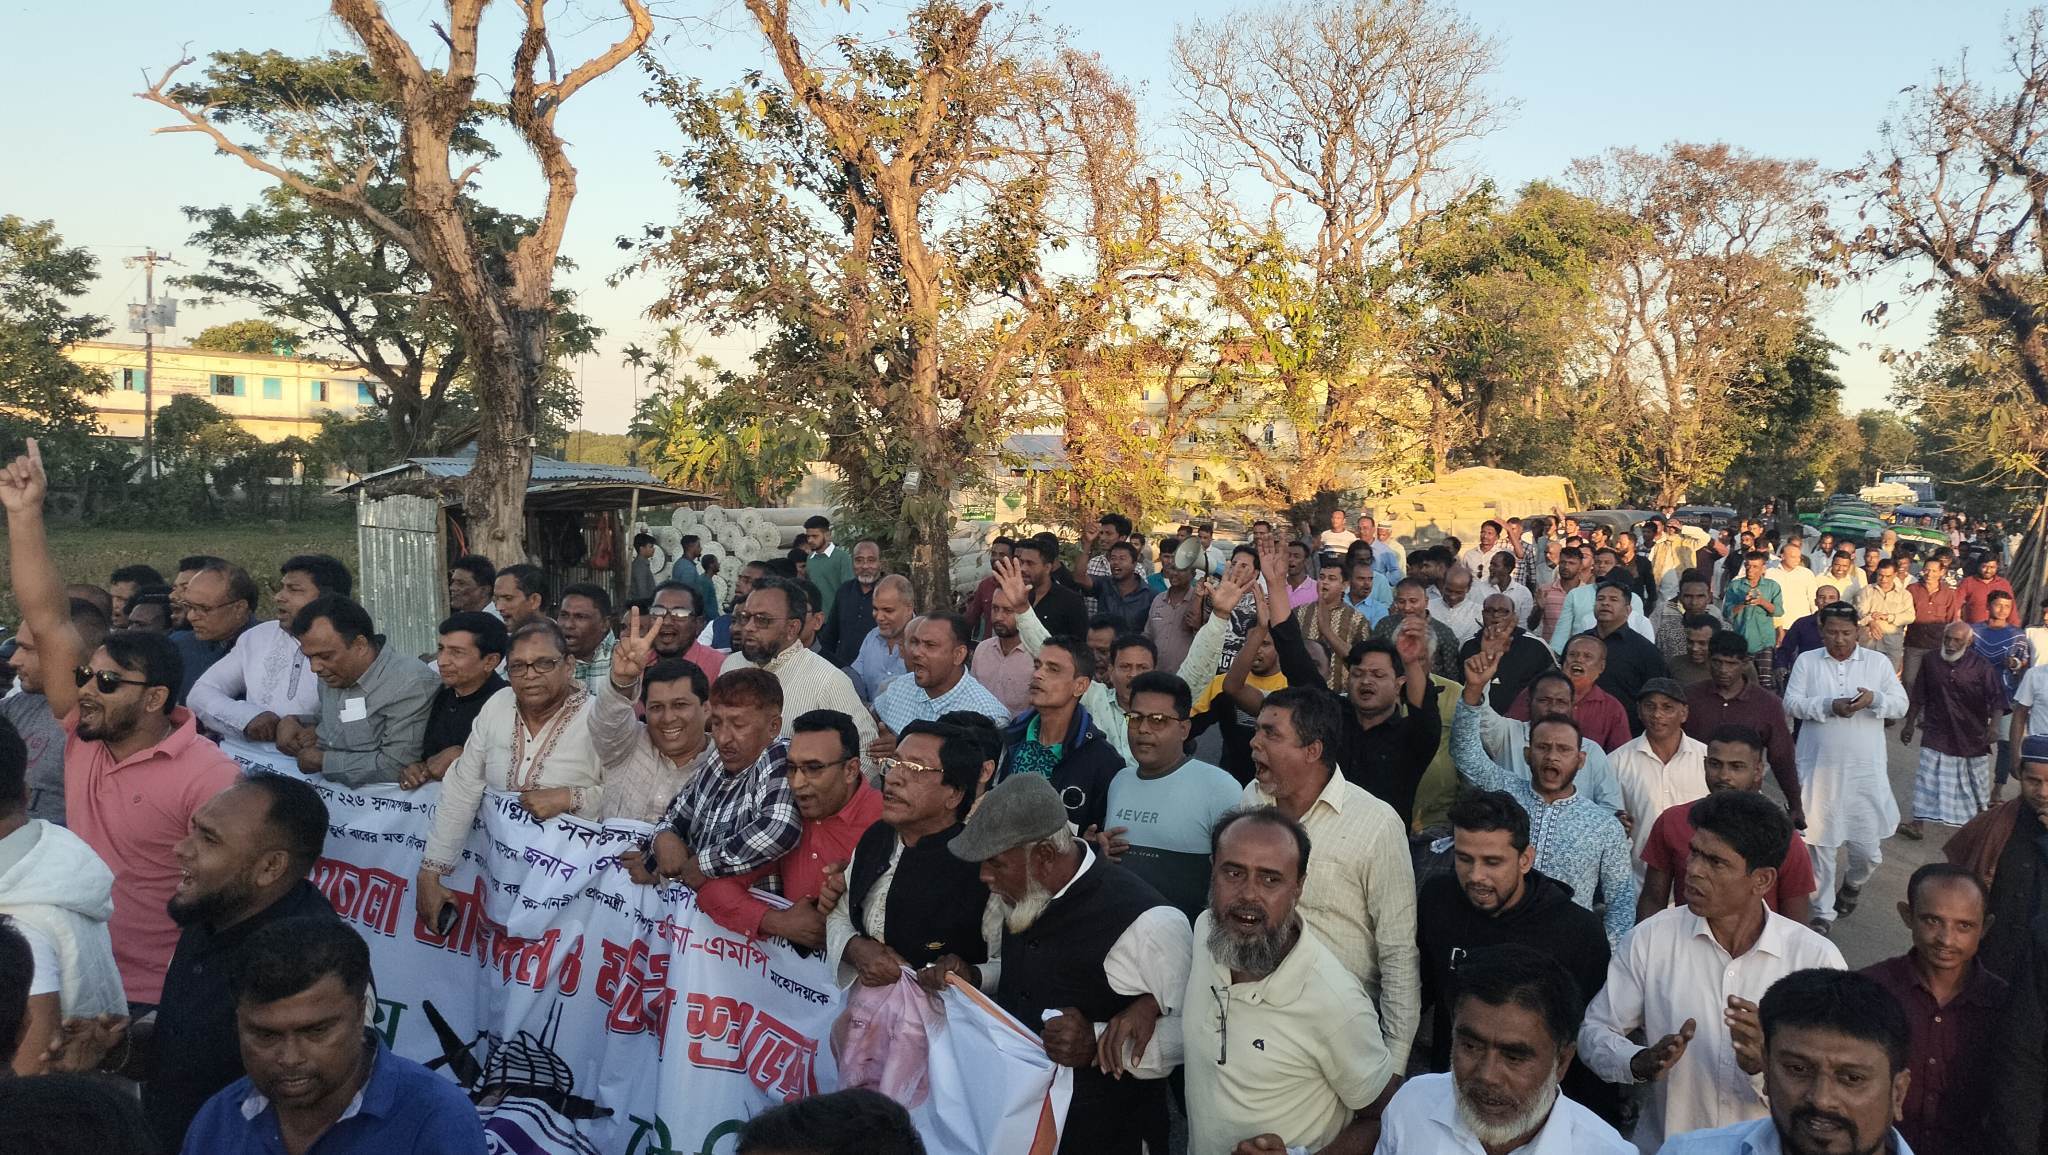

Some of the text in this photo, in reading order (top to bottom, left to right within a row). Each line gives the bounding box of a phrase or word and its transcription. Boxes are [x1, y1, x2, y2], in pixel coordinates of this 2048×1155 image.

[1116, 808, 1159, 824] 4EVER
[338, 792, 365, 807] ২২৬
[523, 846, 578, 882] জনাব
[349, 828, 378, 843] বারের
[382, 833, 405, 843] মত
